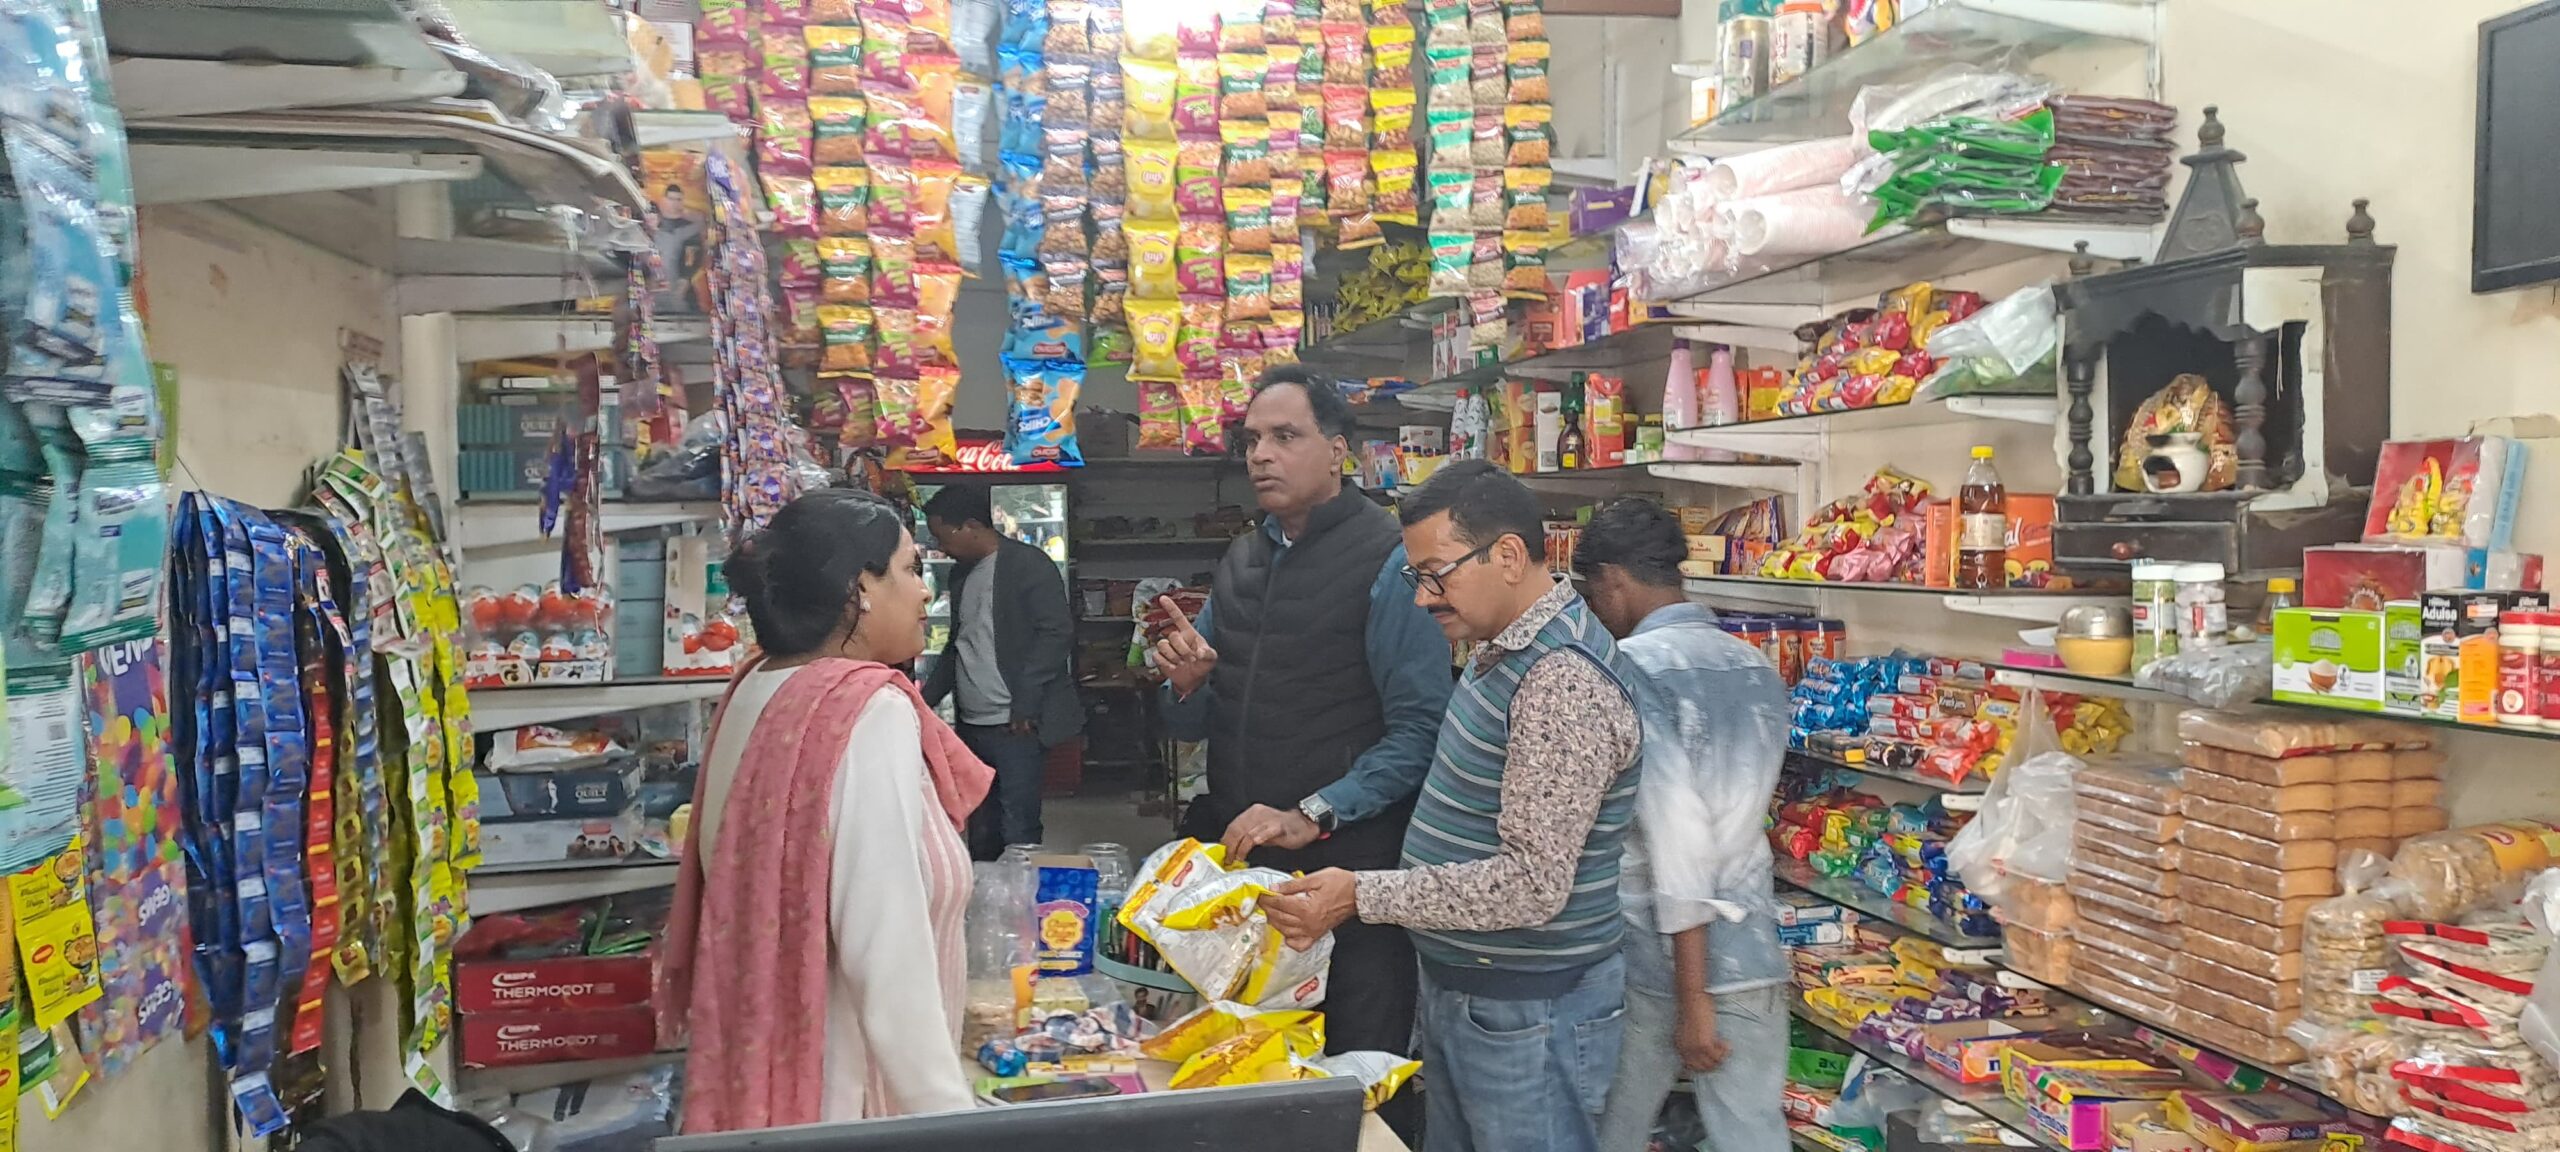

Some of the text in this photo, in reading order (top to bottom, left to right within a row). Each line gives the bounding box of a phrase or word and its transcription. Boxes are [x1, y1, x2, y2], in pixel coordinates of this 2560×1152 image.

[575, 788, 608, 798] QUILT
[492, 983, 594, 999] THERMOCOT
[497, 1035, 598, 1051] THERMOCOT
